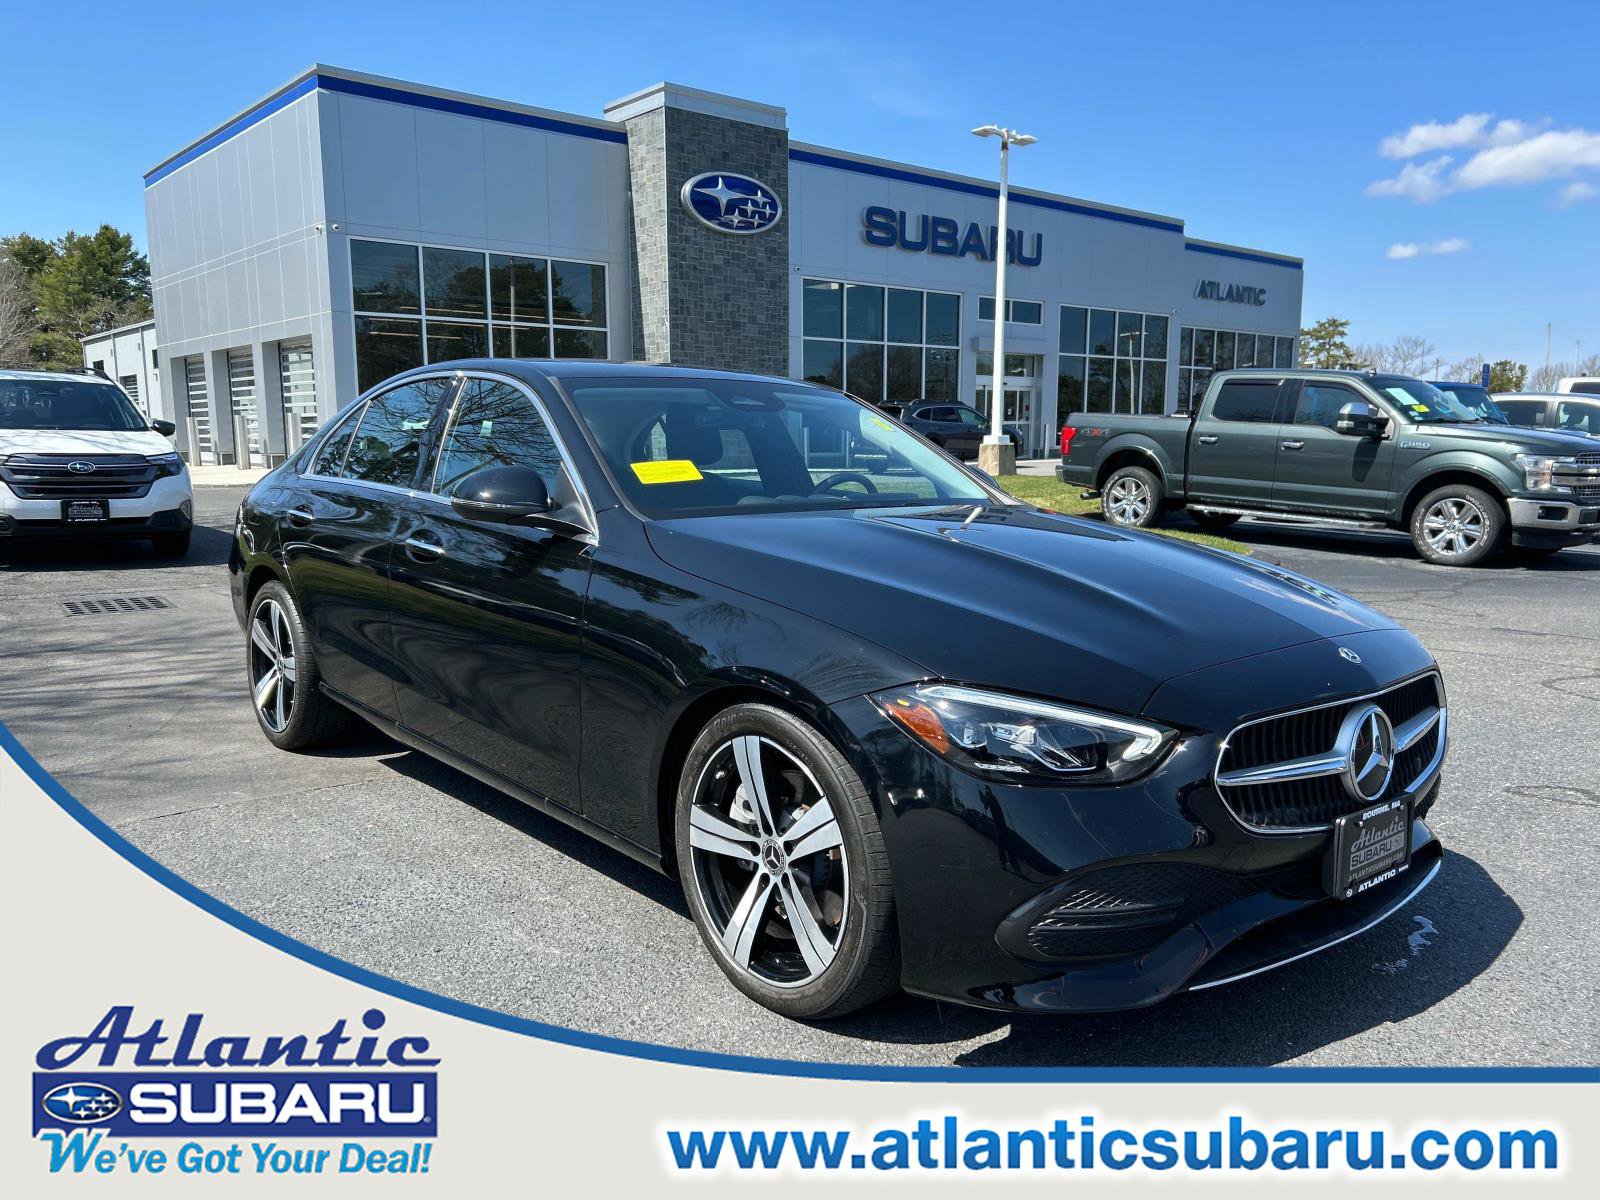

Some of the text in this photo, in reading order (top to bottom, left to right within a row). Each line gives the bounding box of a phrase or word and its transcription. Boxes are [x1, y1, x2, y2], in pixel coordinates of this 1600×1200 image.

[864, 205, 1043, 267] SUBARU
[1194, 279, 1266, 306] ATLANTIC
[1351, 816, 1405, 852] Atlantic
[1351, 840, 1392, 868] SUBARU
[1358, 869, 1396, 892] ATLANTIC
